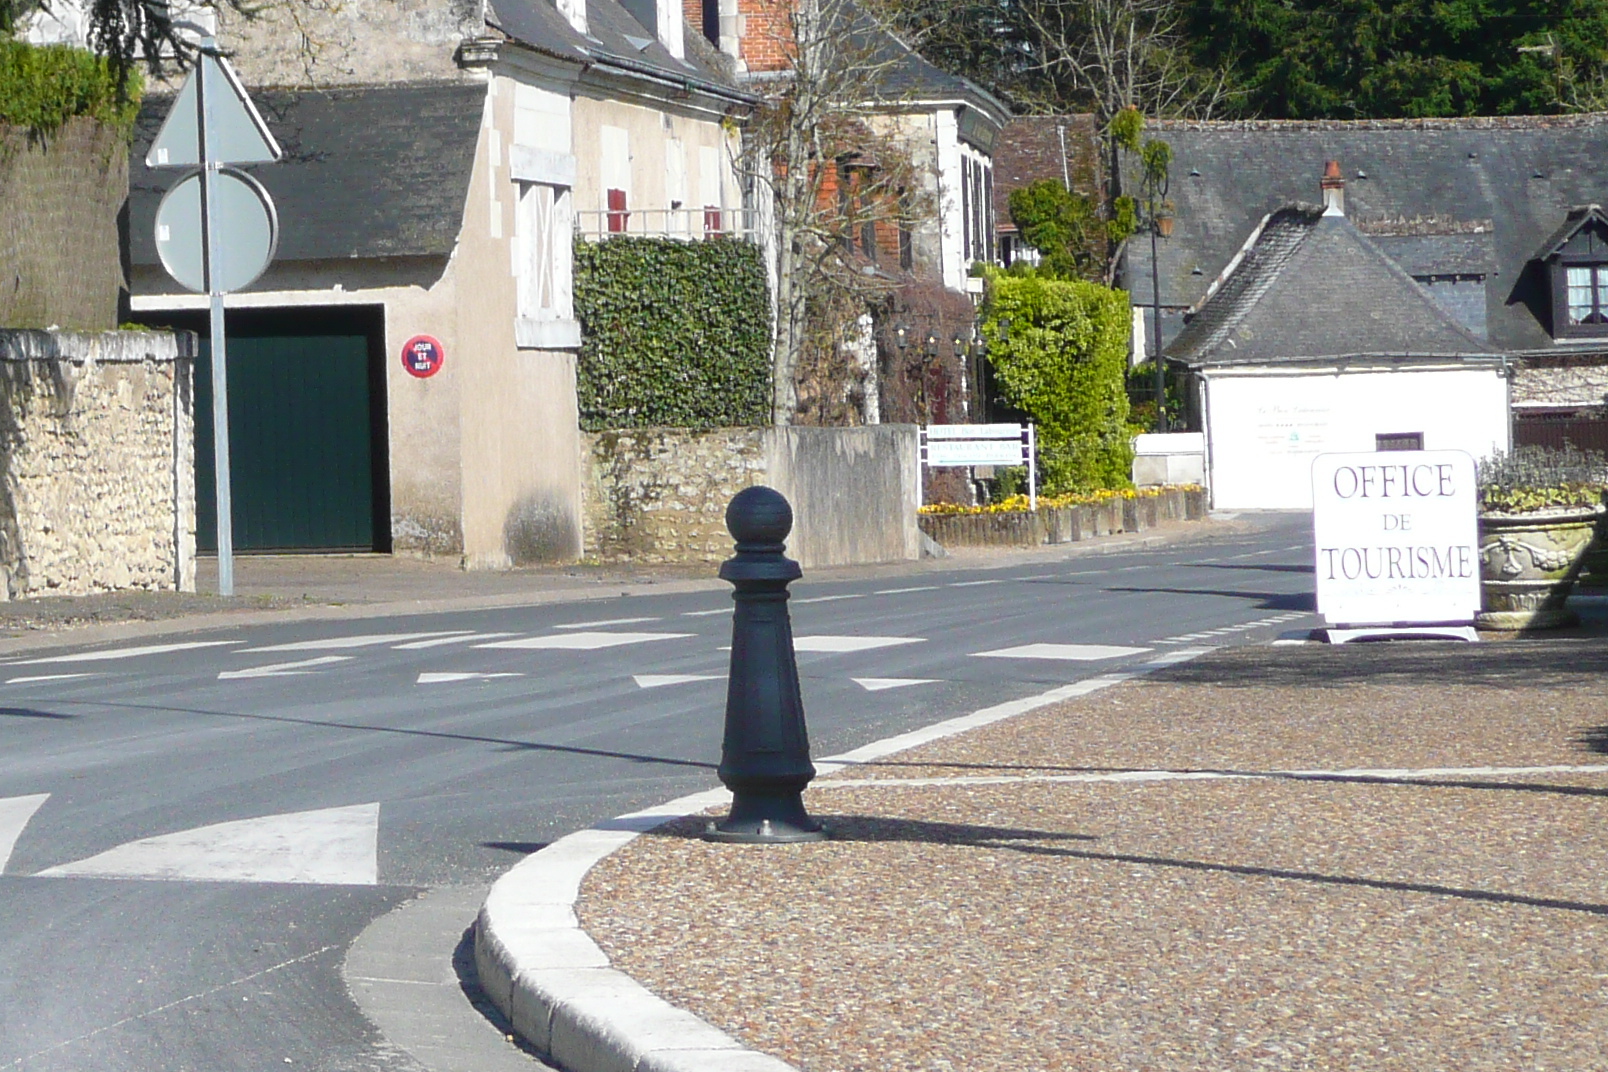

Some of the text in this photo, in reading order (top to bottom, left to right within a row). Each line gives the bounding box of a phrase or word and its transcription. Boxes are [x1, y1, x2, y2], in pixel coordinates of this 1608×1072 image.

[413, 343, 431, 351] JOUR
[418, 352, 427, 360] ET
[415, 362, 431, 370] NUIT
[930, 443, 993, 451] RESTAURANT
[1334, 464, 1456, 499] OFFICE
[1383, 513, 1412, 531] DE
[1321, 545, 1473, 580] TOURISME
